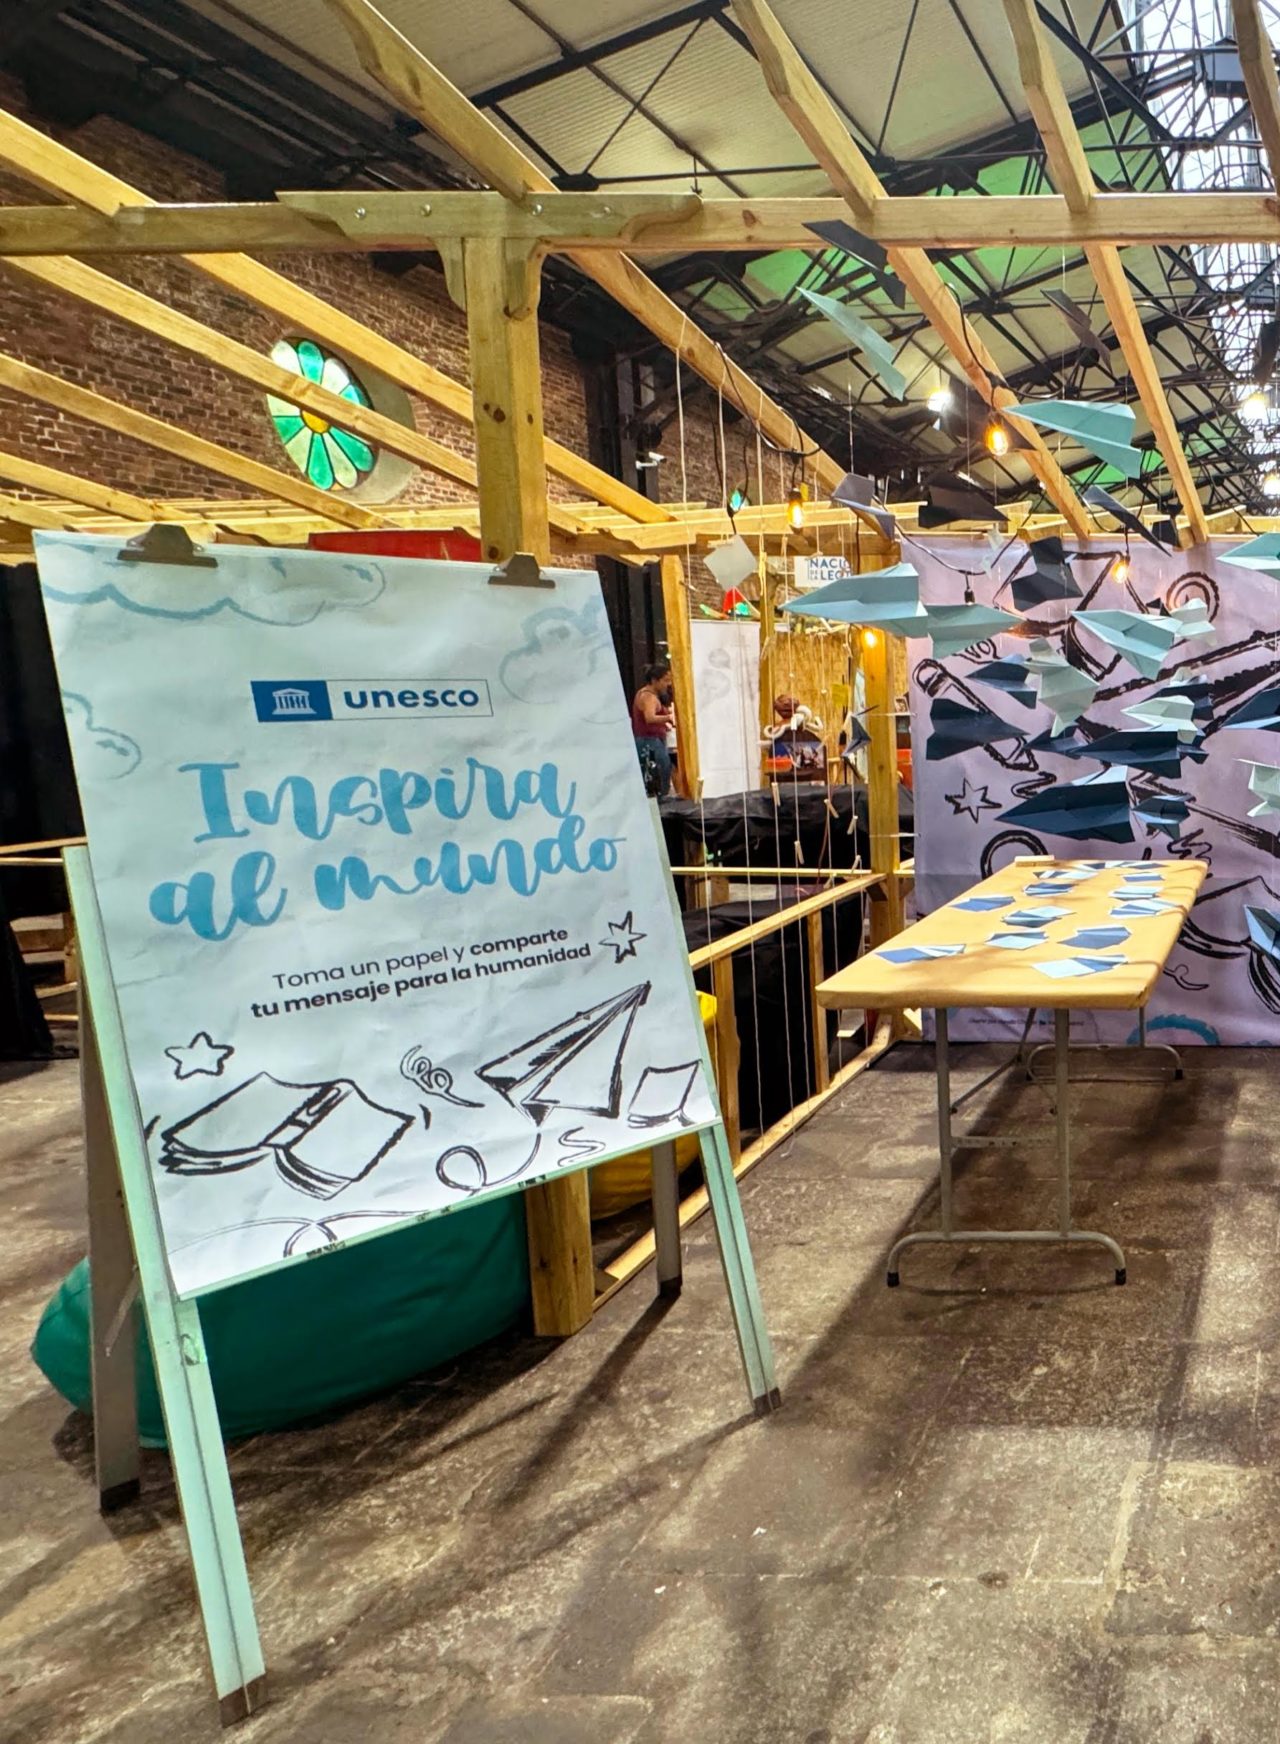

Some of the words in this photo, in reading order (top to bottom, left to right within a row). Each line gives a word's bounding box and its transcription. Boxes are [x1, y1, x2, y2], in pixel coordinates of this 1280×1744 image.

[344, 688, 479, 709] unesco
[177, 757, 577, 843] Inspira
[148, 850, 288, 942] al
[314, 814, 627, 911] mundo
[251, 1000, 280, 1019] tu
[283, 981, 392, 1013] mensaje
[395, 971, 449, 996] para
[451, 966, 472, 982] la
[475, 943, 592, 978] humanidad
[273, 966, 345, 990] Toma
[351, 962, 380, 977] un
[386, 947, 449, 976] papel
[453, 947, 465, 965] y
[469, 929, 569, 958] comparte
